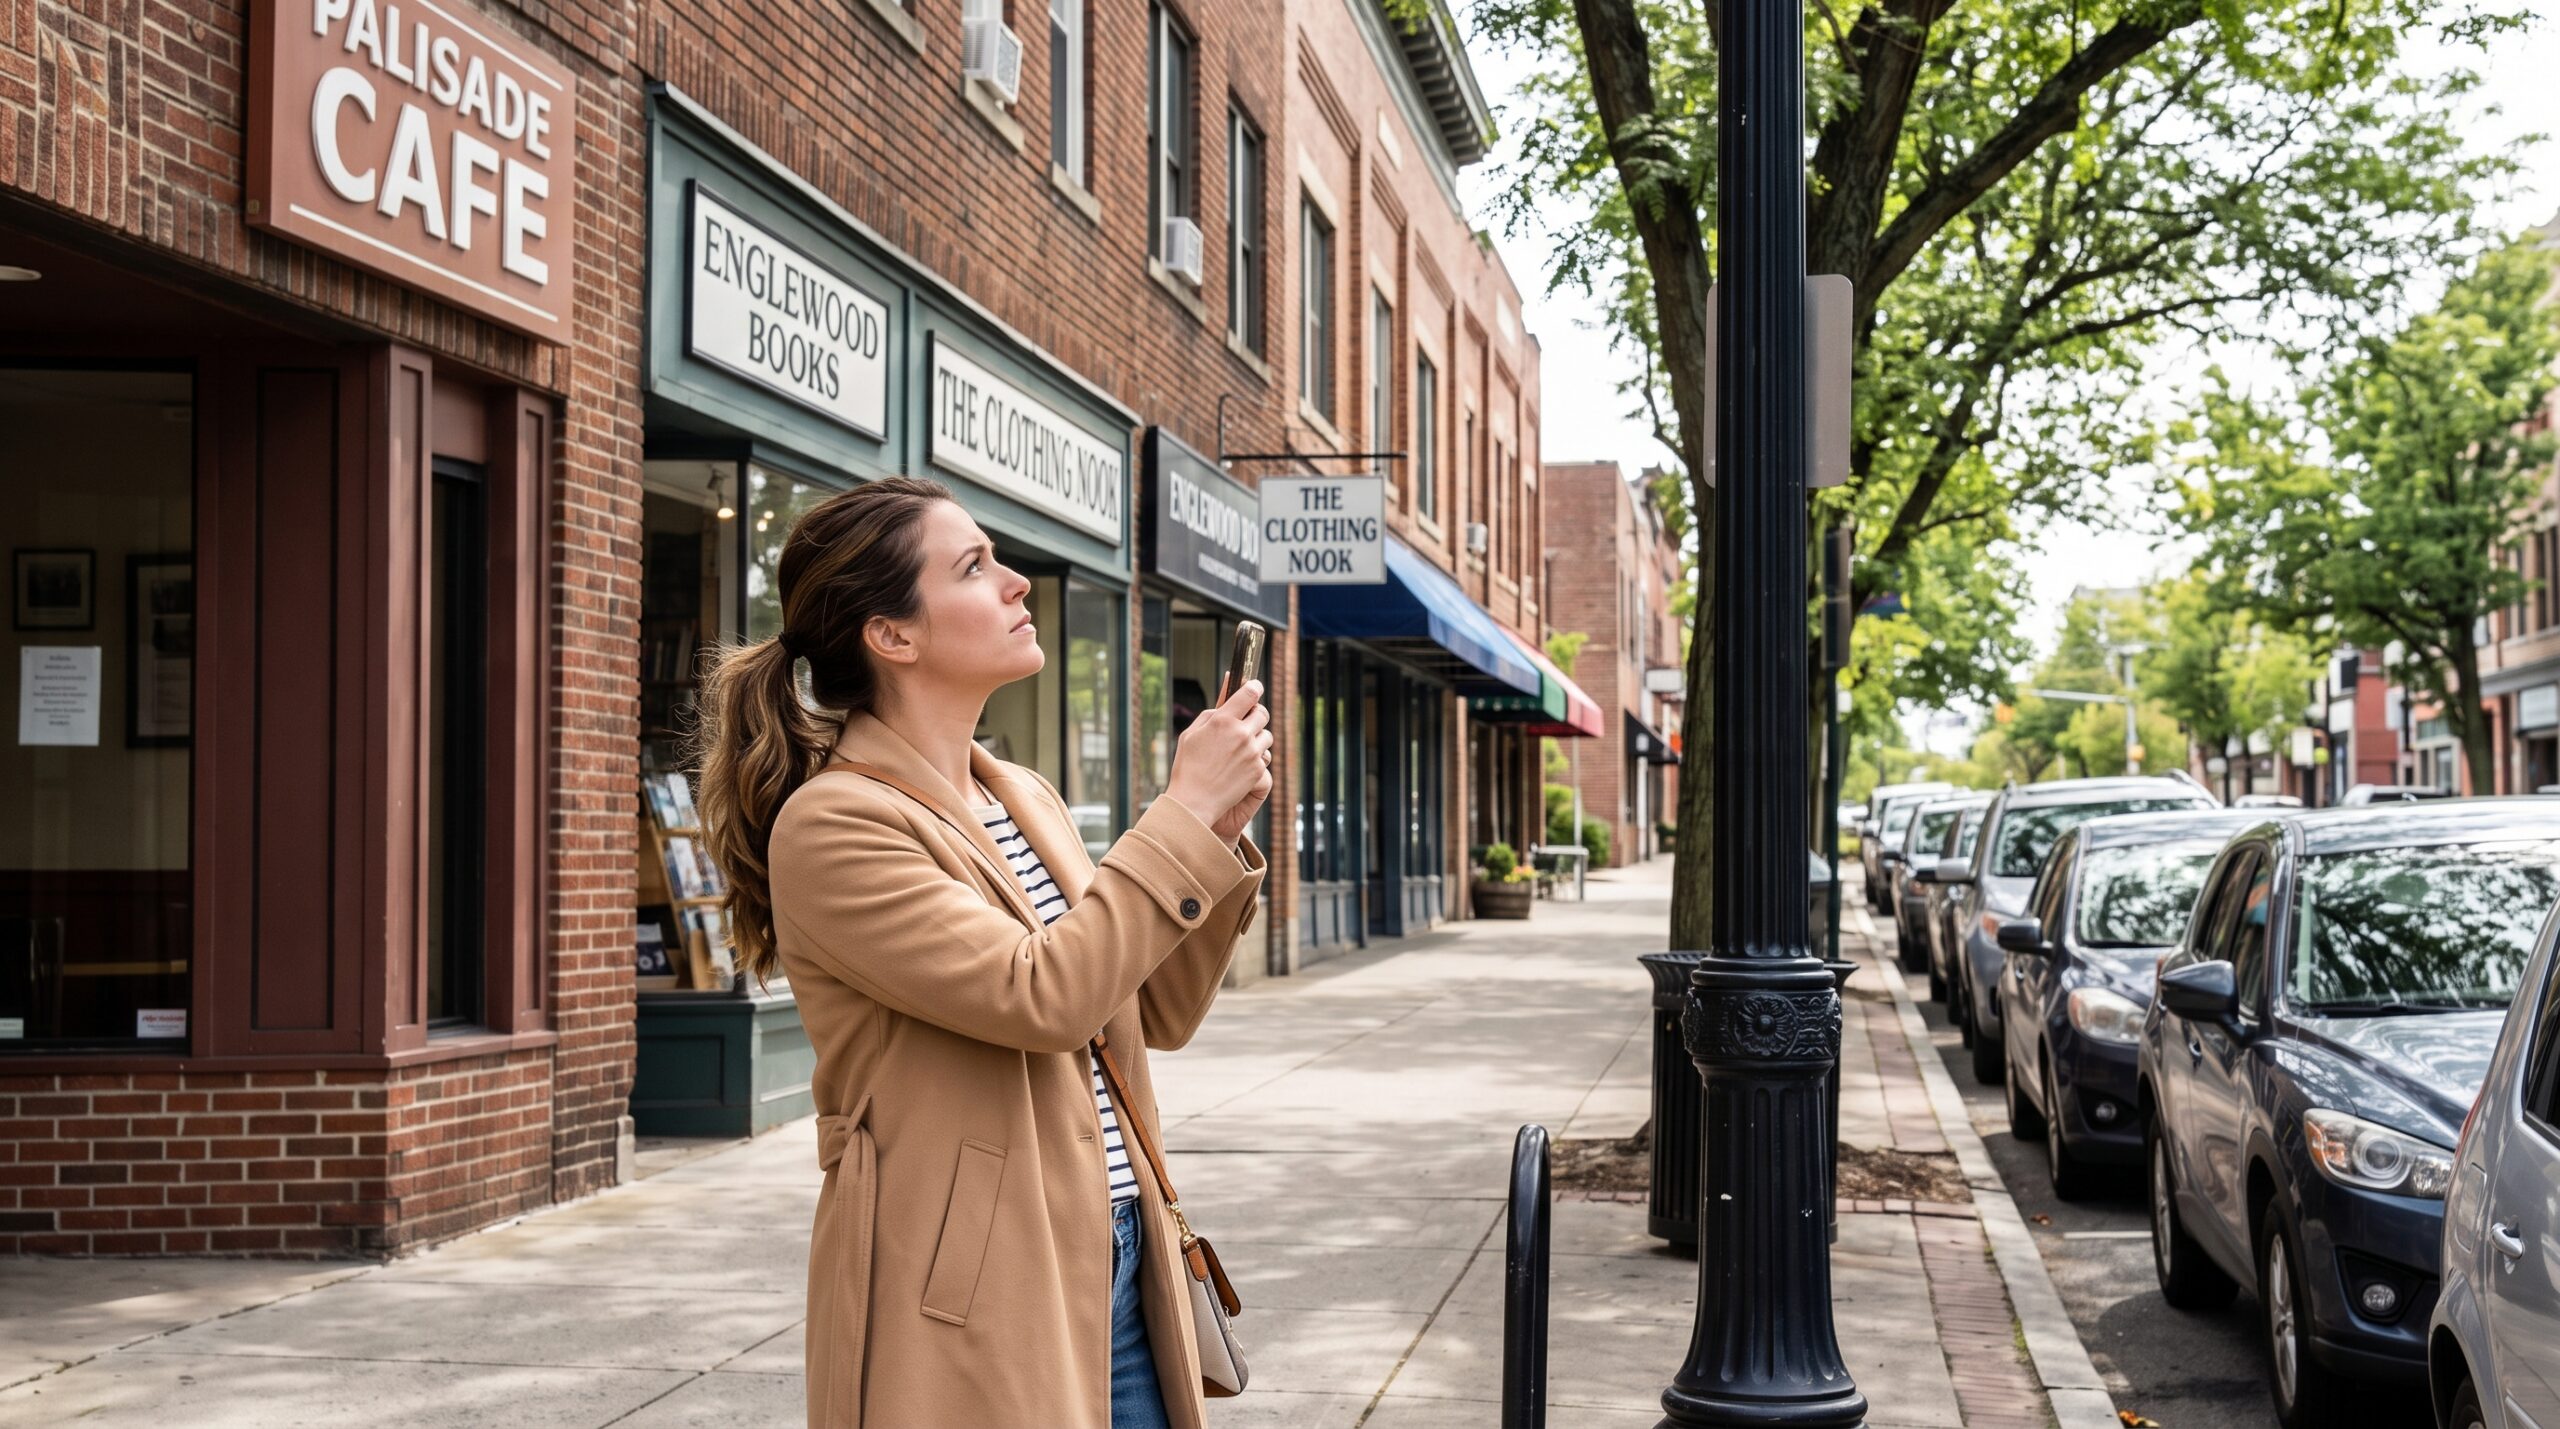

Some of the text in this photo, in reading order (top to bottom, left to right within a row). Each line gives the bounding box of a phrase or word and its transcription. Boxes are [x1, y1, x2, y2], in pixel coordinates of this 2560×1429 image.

[311, 66, 549, 286] CAFE
[703, 215, 878, 360] ENGLEWOOD
[748, 310, 840, 400] BOOKS
[939, 366, 1119, 522] THE CLOTHING NOOK
[1169, 470, 1241, 555] ENGLEWOOD
[1264, 518, 1378, 543] CLOTHING
[1300, 486, 1344, 511] THE
[1288, 550, 1353, 574] NOOK
